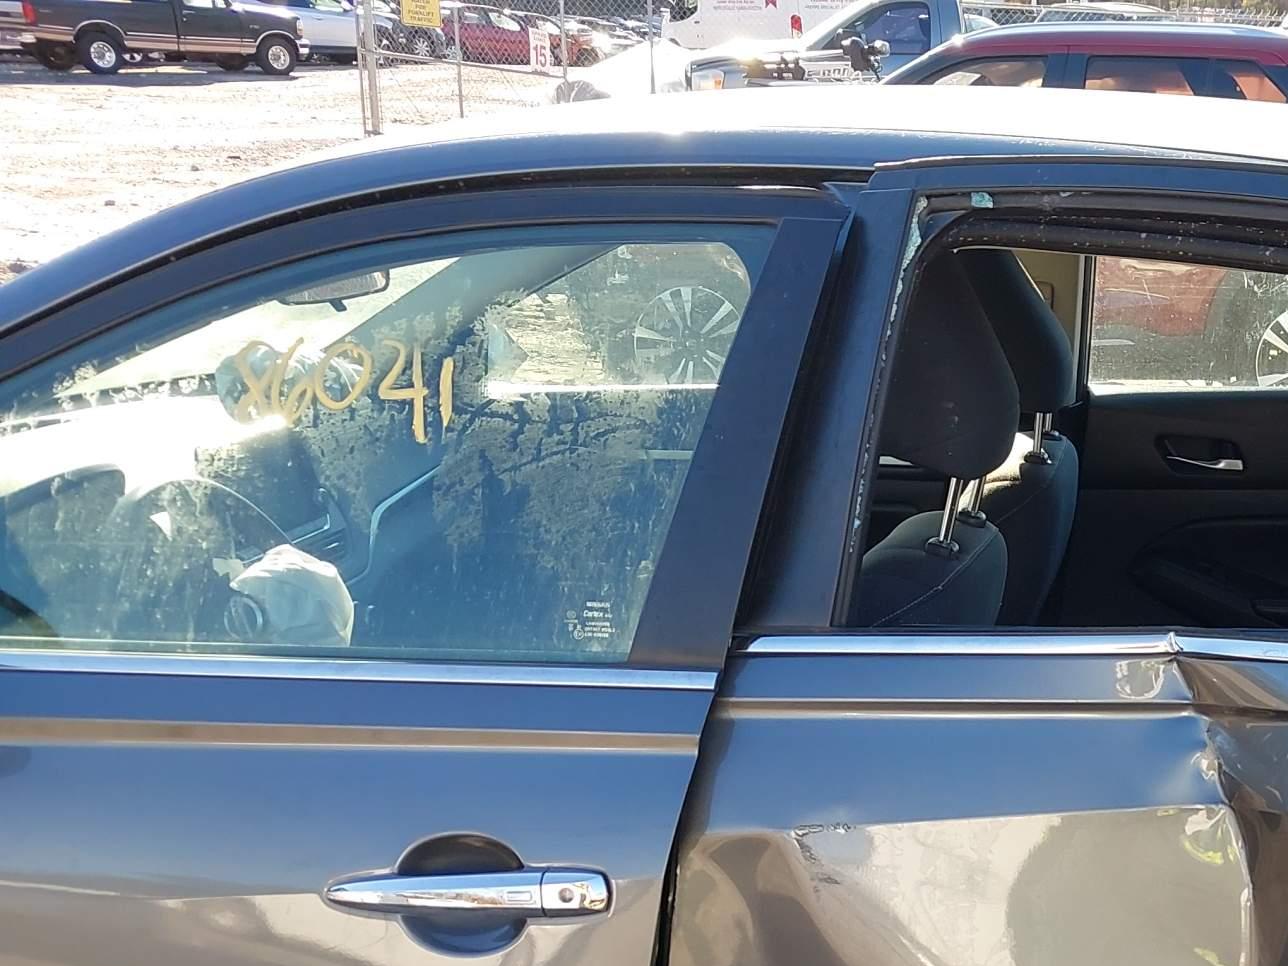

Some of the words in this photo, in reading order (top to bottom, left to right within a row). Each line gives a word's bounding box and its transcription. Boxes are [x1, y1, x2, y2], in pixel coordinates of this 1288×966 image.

[408, 9, 434, 17] FORKLIFT
[533, 44, 547, 68] 15
[234, 337, 454, 443] 86041
